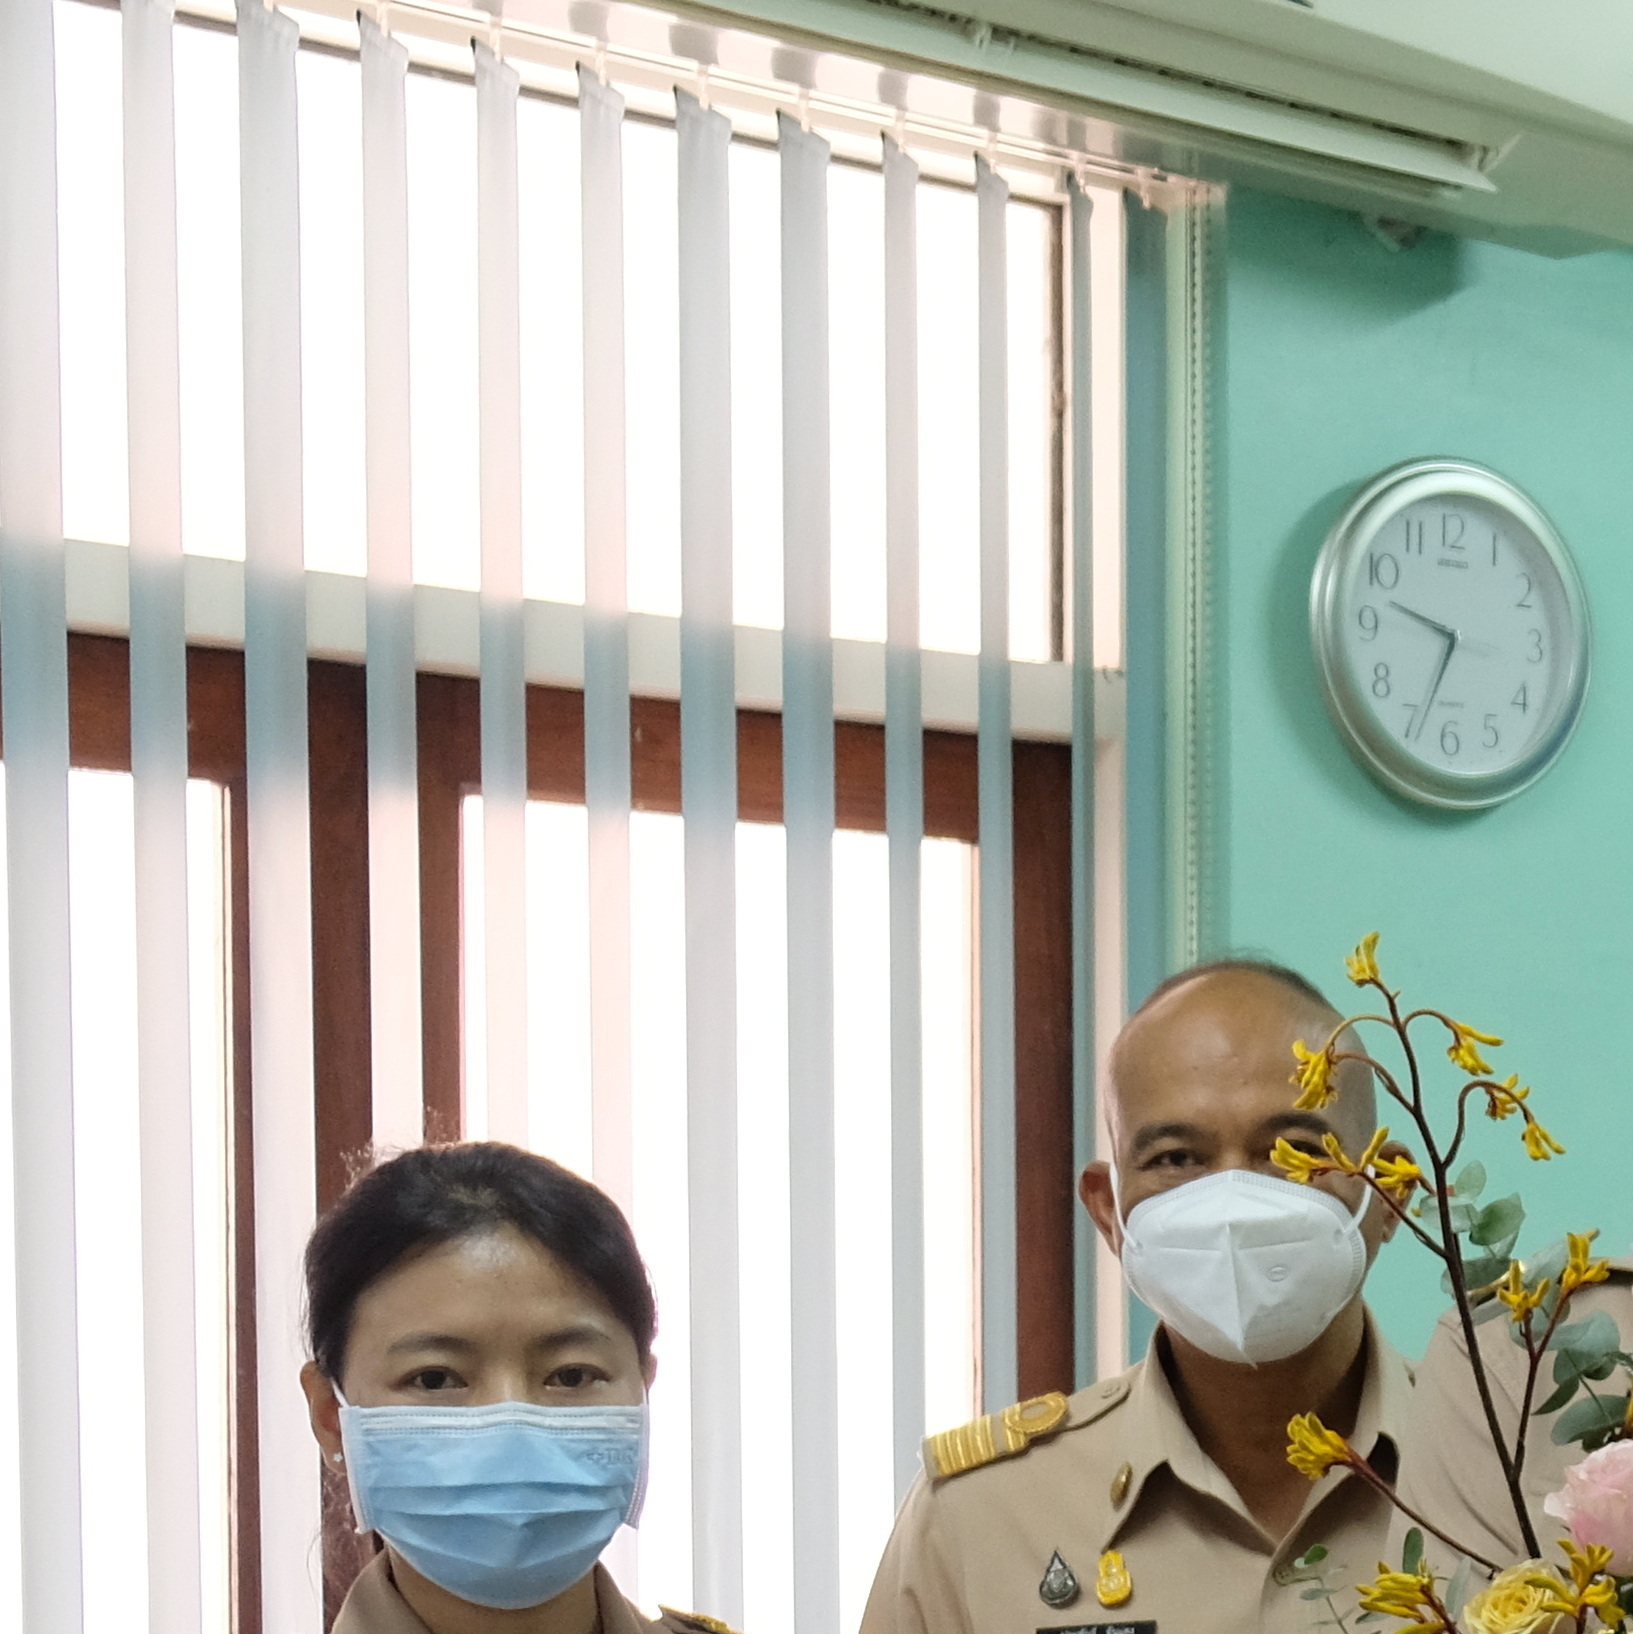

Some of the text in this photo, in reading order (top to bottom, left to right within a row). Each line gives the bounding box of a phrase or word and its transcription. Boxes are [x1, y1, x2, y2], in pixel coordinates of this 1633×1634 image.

[1405, 518, 1422, 554] 11
[1442, 513, 1466, 550] 12
[1491, 534, 1497, 566] 1
[1368, 553, 1400, 590] 10
[1516, 572, 1532, 608] 2
[1358, 605, 1378, 641] 9
[1528, 628, 1542, 663] 3
[1372, 662, 1391, 698] 8
[1511, 680, 1528, 714] 4
[1403, 703, 1418, 738] 7
[1482, 714, 1499, 748] 5
[1440, 721, 1460, 756] 6
